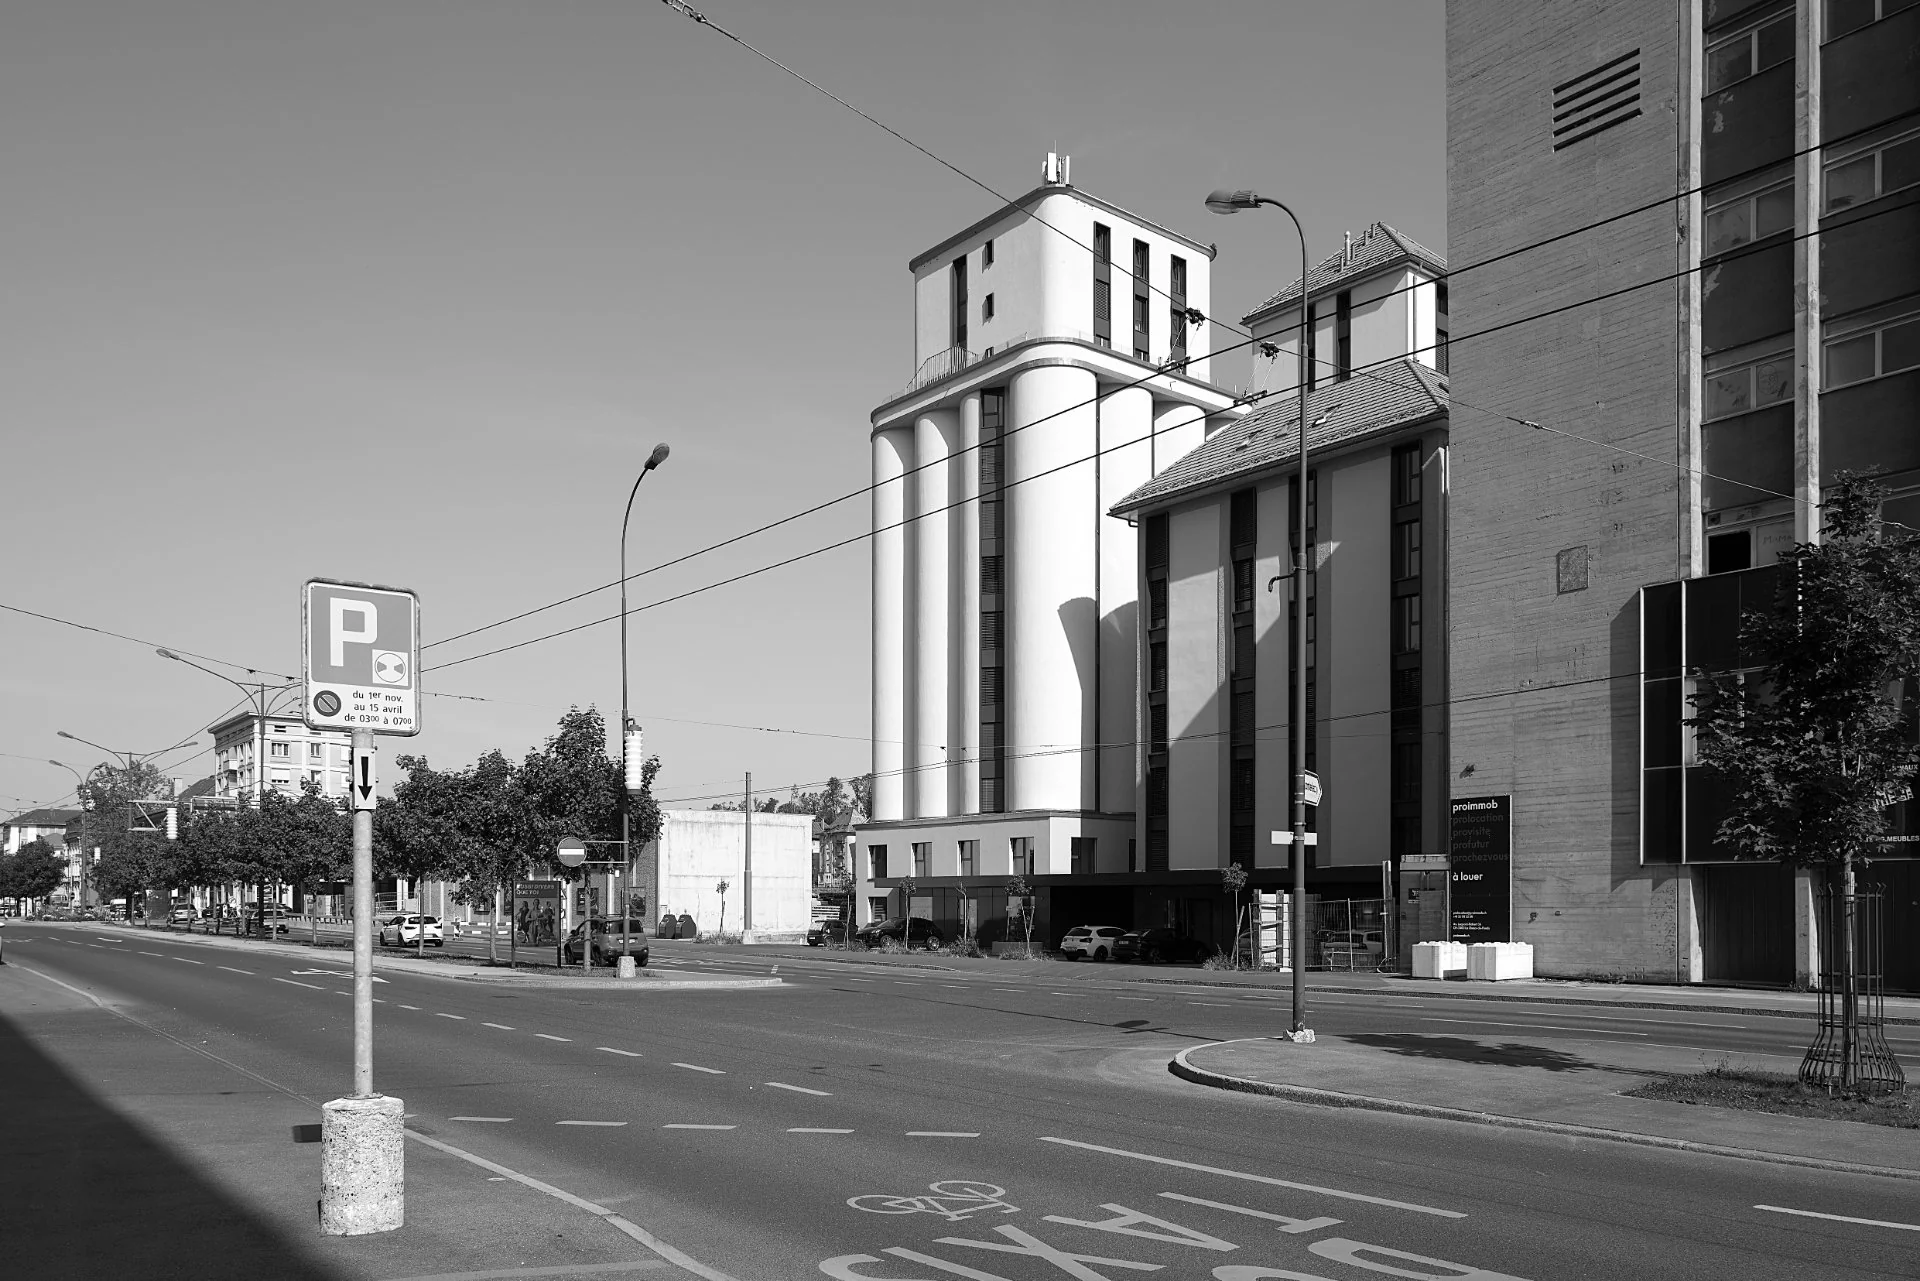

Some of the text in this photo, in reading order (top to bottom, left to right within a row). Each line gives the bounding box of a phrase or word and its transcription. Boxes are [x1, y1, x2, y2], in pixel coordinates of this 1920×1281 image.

[330, 597, 378, 667] P
[352, 690, 404, 702] du 1er nov.
[369, 703, 379, 712] 15
[382, 705, 402, 714] avril
[344, 713, 356, 722] de
[383, 716, 389, 725] à
[1453, 800, 1498, 814] proimmob
[1453, 813, 1504, 827] prolocation
[1453, 826, 1491, 839] provisite
[1453, 839, 1489, 852] profutur
[1453, 871, 1484, 881] à louer
